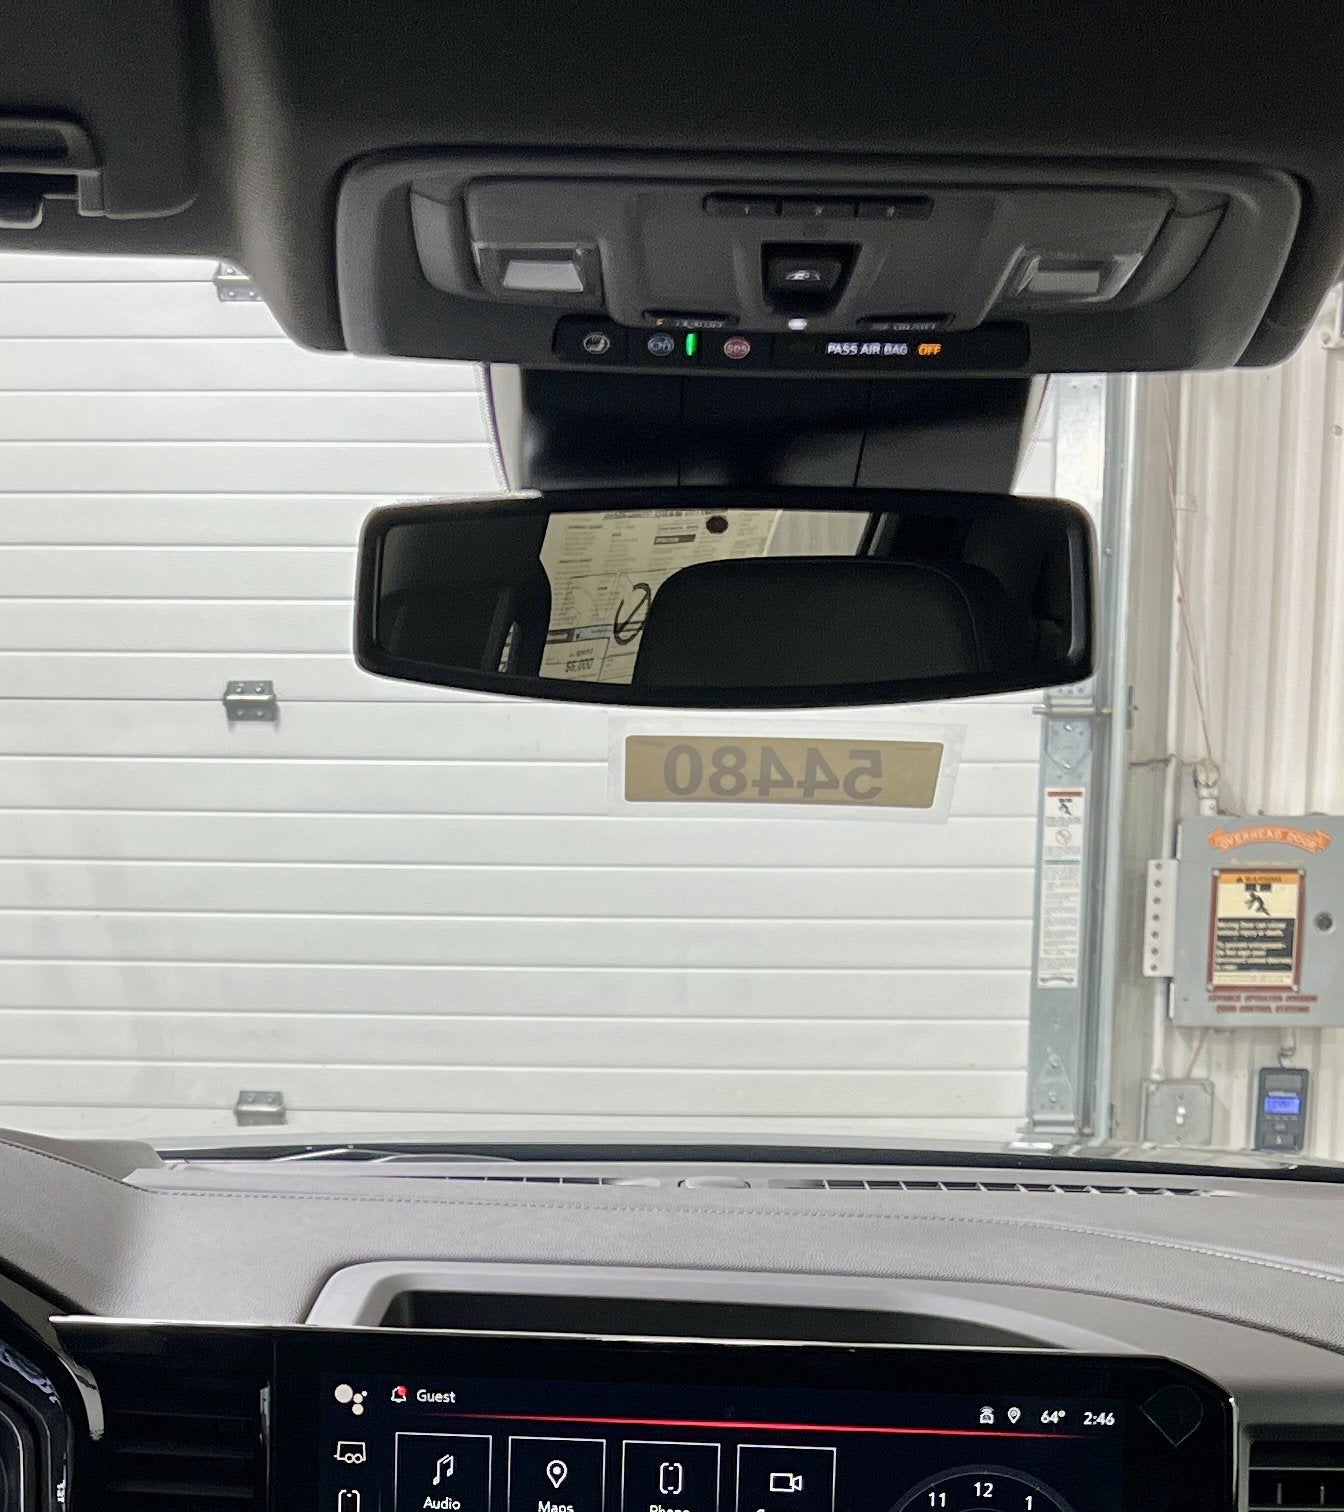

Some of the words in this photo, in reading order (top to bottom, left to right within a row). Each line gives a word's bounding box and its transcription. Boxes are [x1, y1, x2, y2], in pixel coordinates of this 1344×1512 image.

[828, 343, 857, 355] PASS
[860, 343, 880, 354] AIR
[884, 343, 907, 355] BAG
[917, 342, 942, 356] OFF
[417, 1390, 455, 1403] Guest
[1084, 1412, 1114, 1425] 2:46
[974, 1482, 993, 1497] 12
[423, 1497, 460, 1510] Audio
[929, 1492, 945, 1507] 11
[1026, 1496, 1032, 1510] 1
